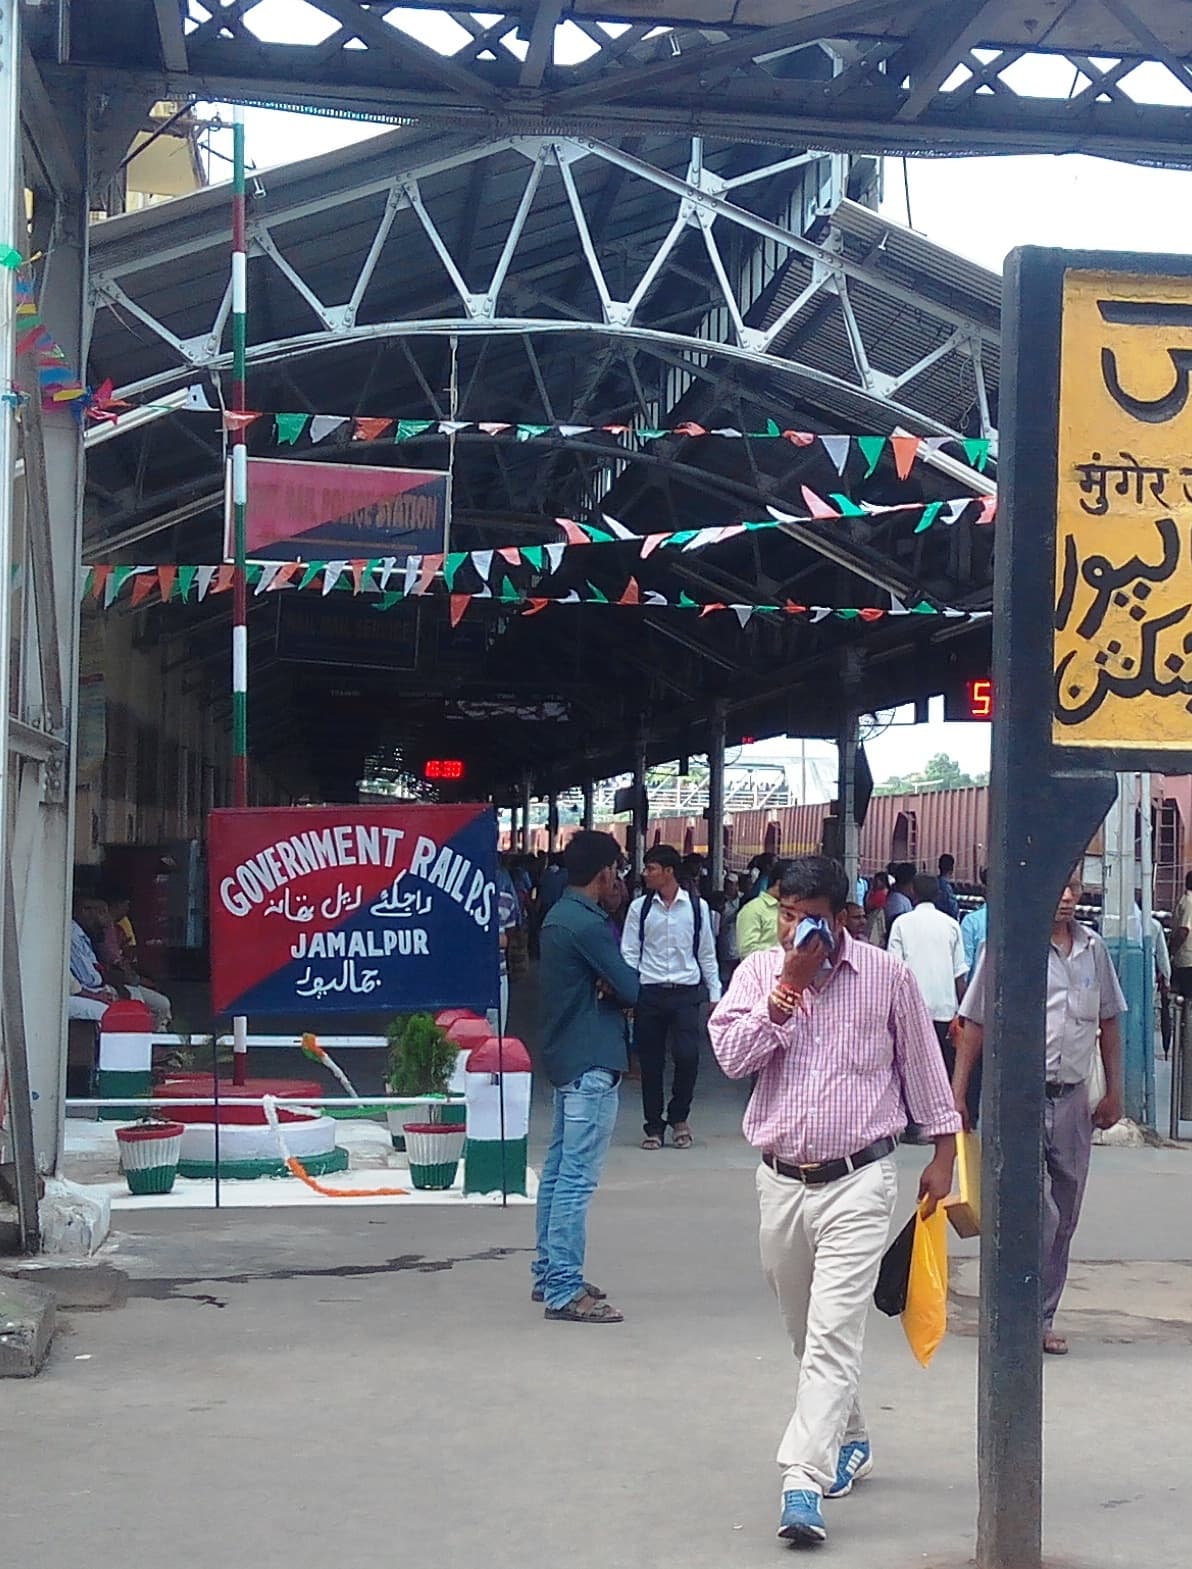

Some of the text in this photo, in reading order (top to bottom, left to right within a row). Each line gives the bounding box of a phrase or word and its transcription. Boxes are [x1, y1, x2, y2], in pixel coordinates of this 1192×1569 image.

[1075, 452, 1170, 516] मुंगेर
[220, 825, 404, 917] GOVERNMENT
[290, 928, 430, 959] JAMALPUR
